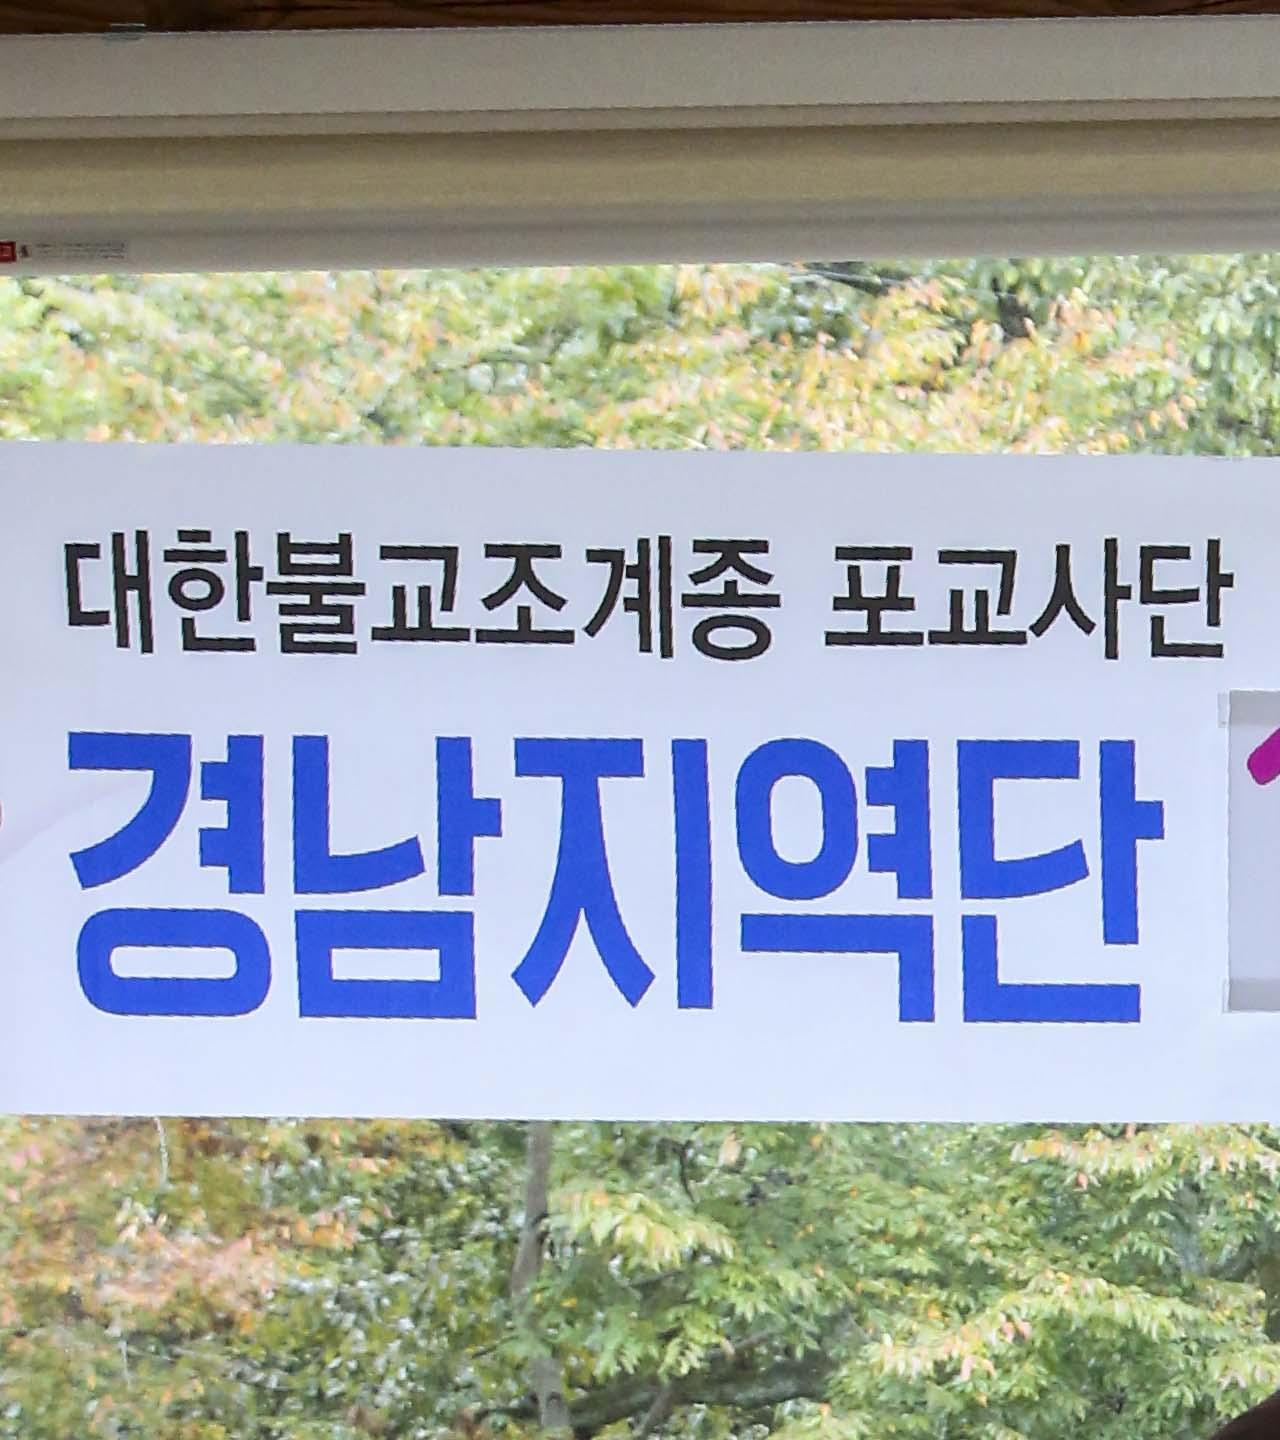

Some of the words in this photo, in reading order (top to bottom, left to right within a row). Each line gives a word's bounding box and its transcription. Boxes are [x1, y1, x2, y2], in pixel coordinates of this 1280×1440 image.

[65, 529, 782, 662] 대한불교조계종
[824, 537, 1234, 661] 포교사단
[67, 731, 1165, 1023] 경남지역단
